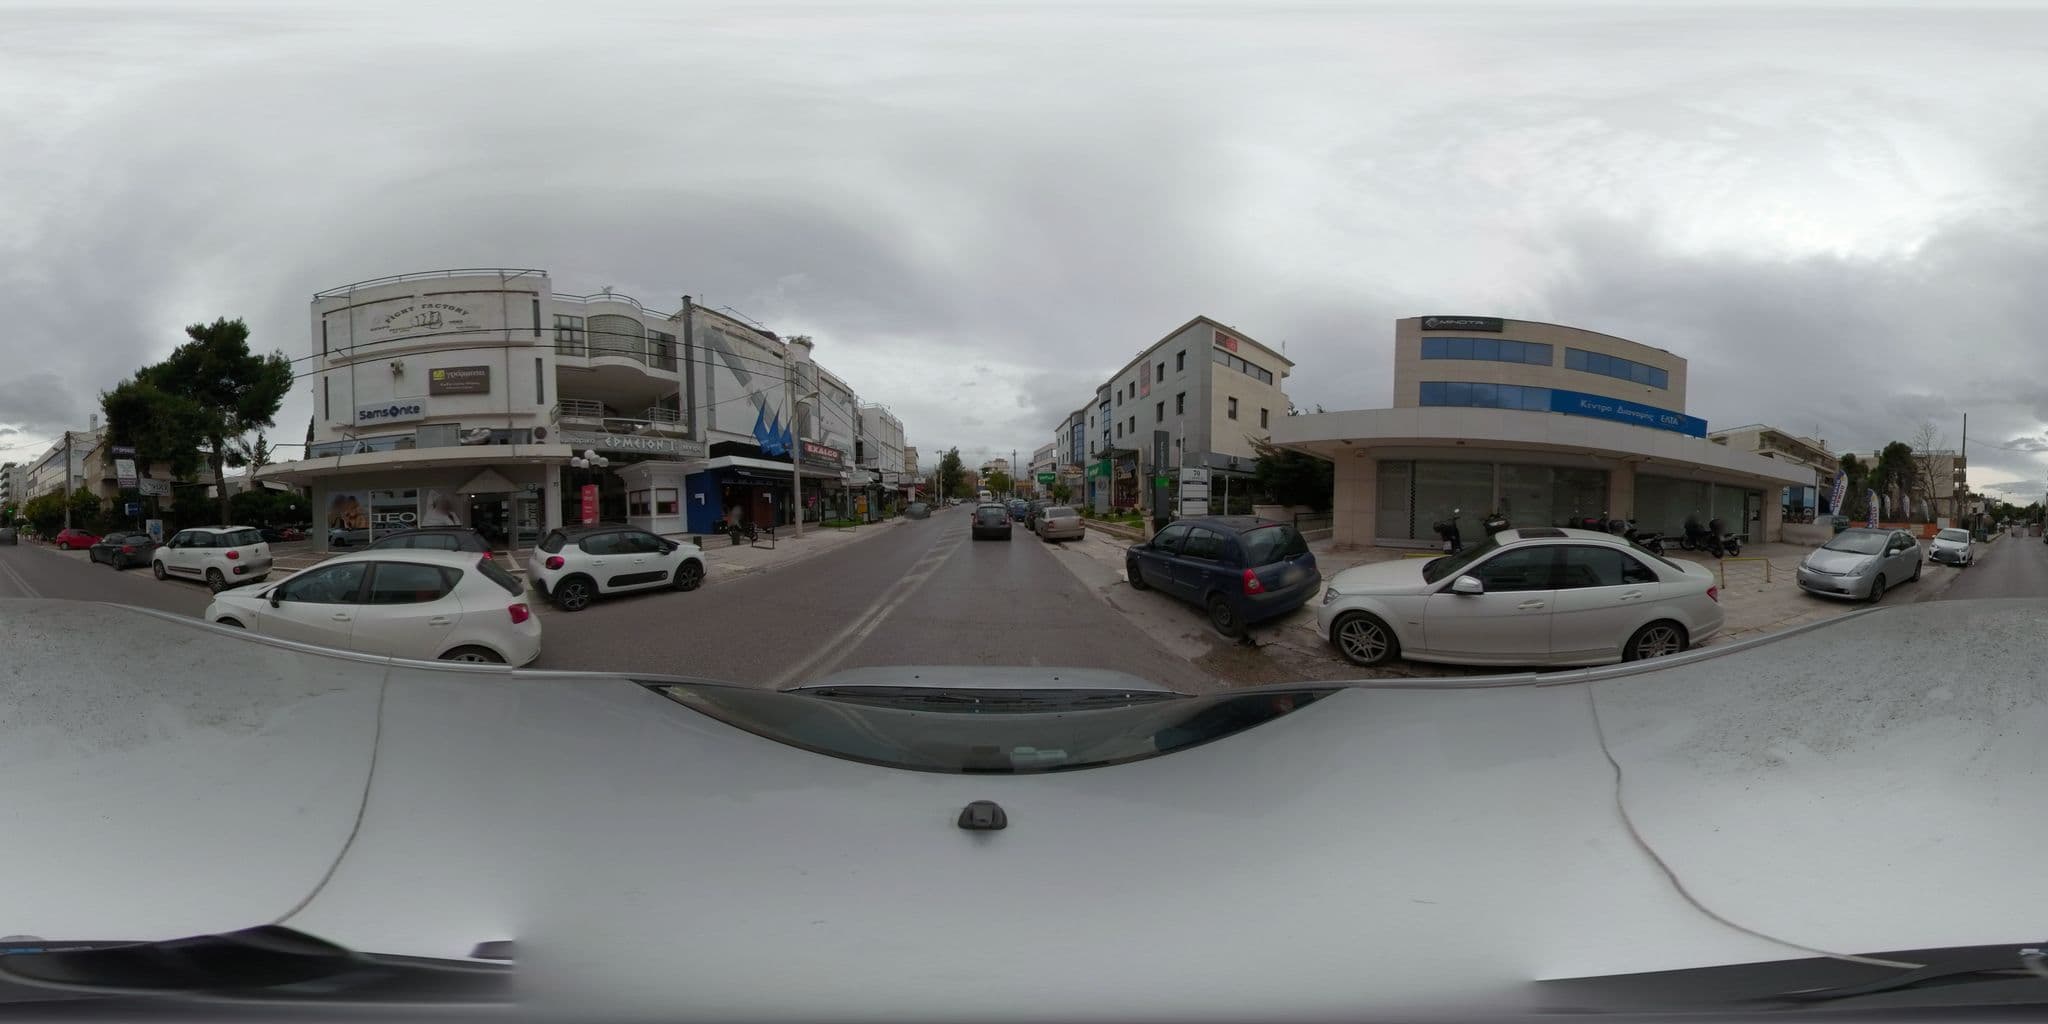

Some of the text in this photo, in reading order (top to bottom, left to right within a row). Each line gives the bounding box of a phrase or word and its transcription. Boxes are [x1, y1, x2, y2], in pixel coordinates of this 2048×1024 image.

[385, 303, 470, 324] FIGHT FACTORY
[807, 444, 838, 458] EXALCO
